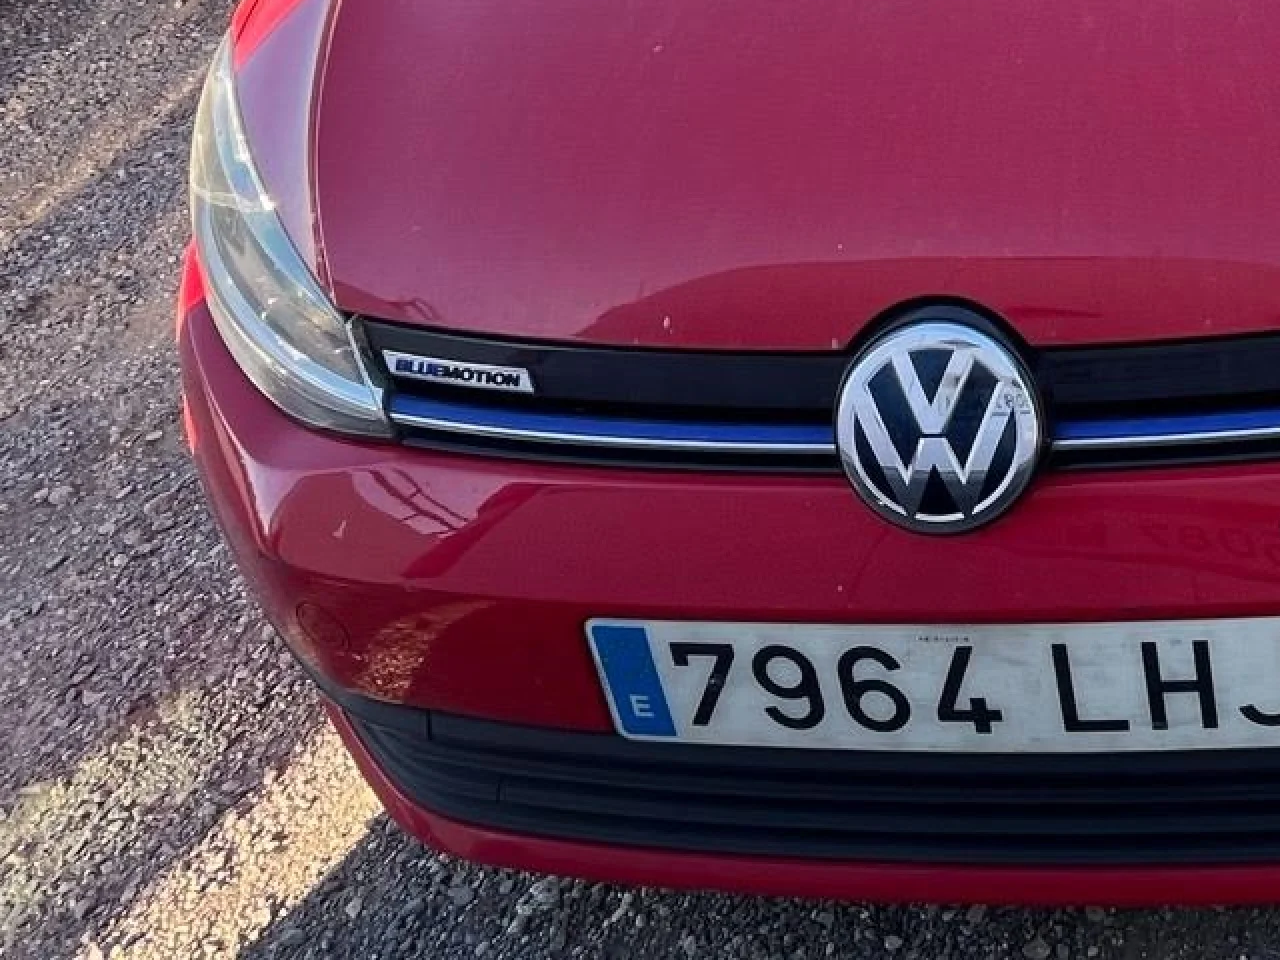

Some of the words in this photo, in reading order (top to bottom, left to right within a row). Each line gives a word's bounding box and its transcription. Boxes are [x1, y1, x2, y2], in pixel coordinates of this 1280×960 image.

[395, 359, 521, 387] BLUEMOTION
[669, 641, 1003, 734] 7964
[630, 695, 654, 717] E
